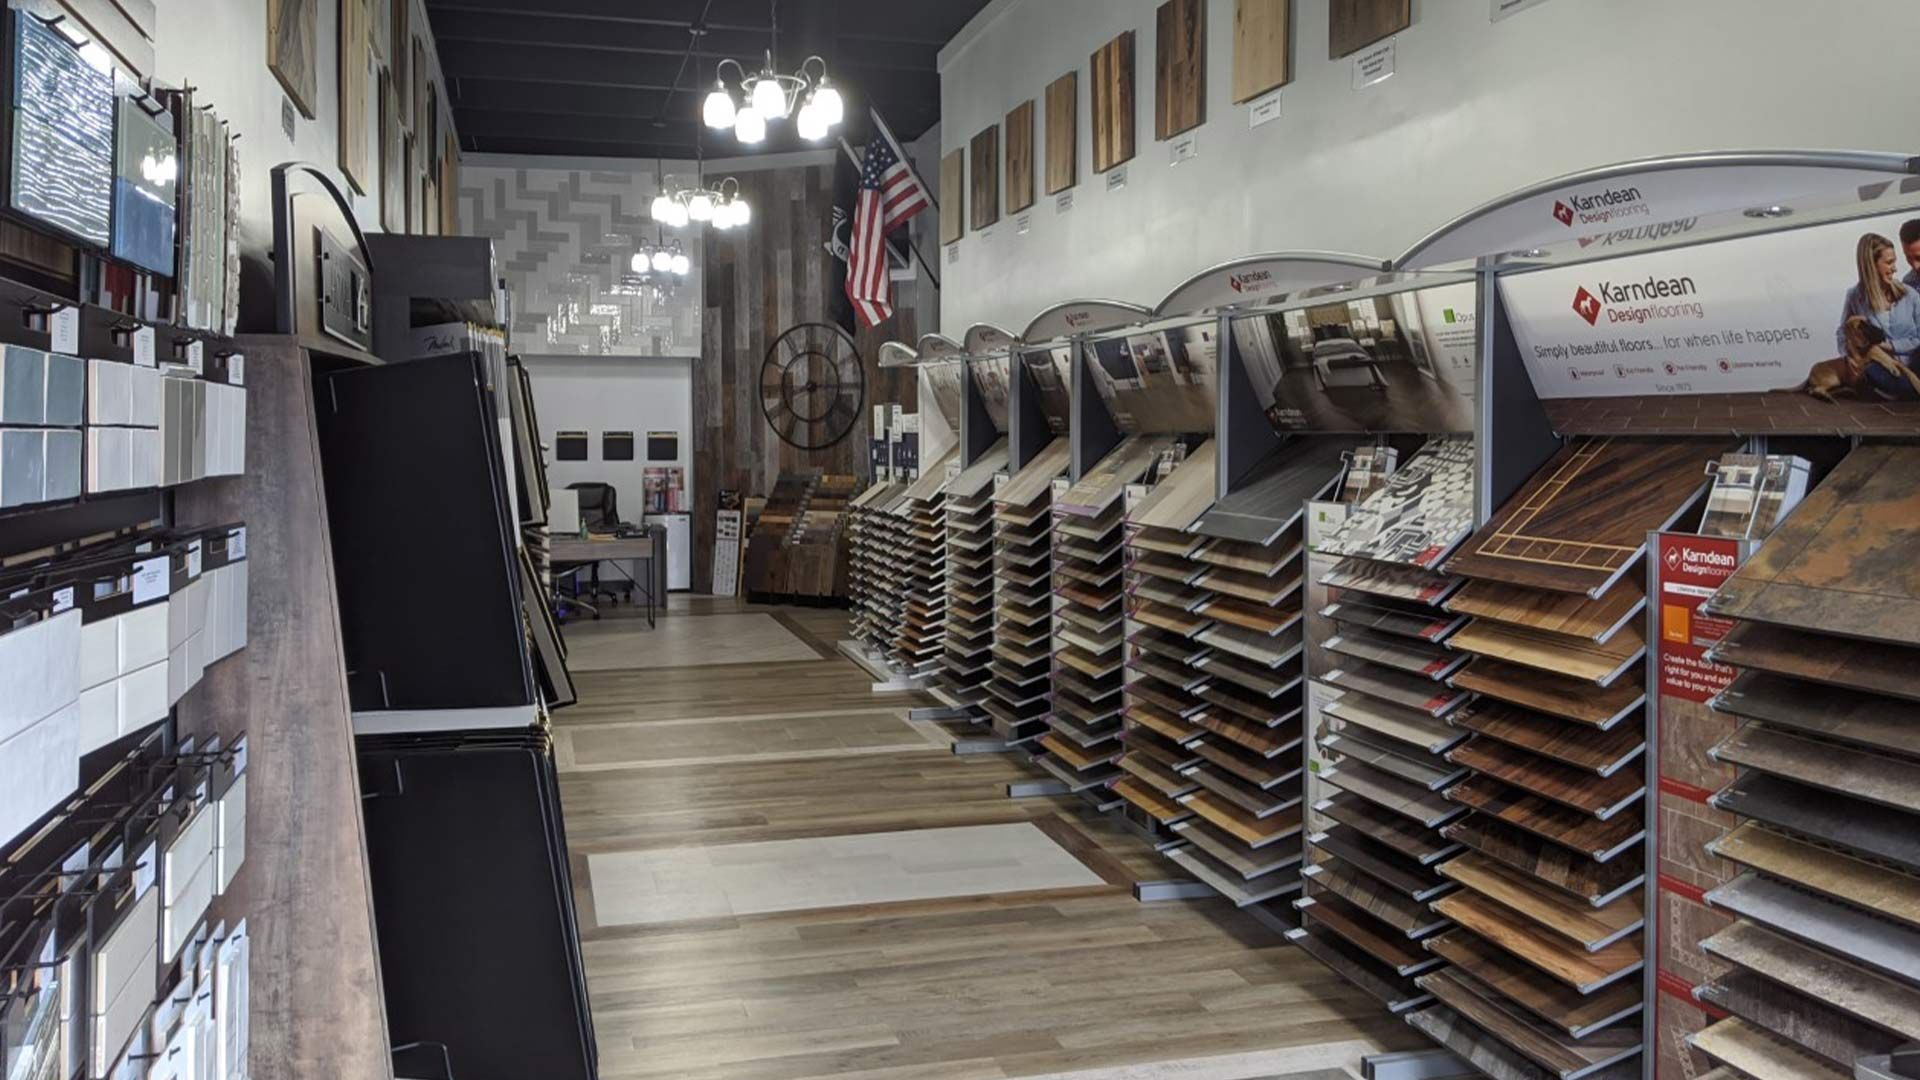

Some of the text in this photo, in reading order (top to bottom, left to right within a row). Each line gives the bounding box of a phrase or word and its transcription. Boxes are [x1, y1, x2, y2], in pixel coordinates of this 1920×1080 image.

[1570, 187, 1641, 212] Karndean
[1579, 203, 1650, 224] Designflooring
[1599, 276, 1696, 304] Karndean
[1607, 301, 1704, 324] Designflooring
[1534, 344, 1568, 361] Simply
[1570, 340, 1619, 356] beautiful
[1662, 335, 1682, 350] for
[1682, 332, 1720, 348] when
[1722, 329, 1744, 346] life
[1745, 326, 1810, 344] happens
[1682, 547, 1735, 567] Karndean
[1663, 652, 1685, 664] Create
[1686, 656, 1697, 667] the
